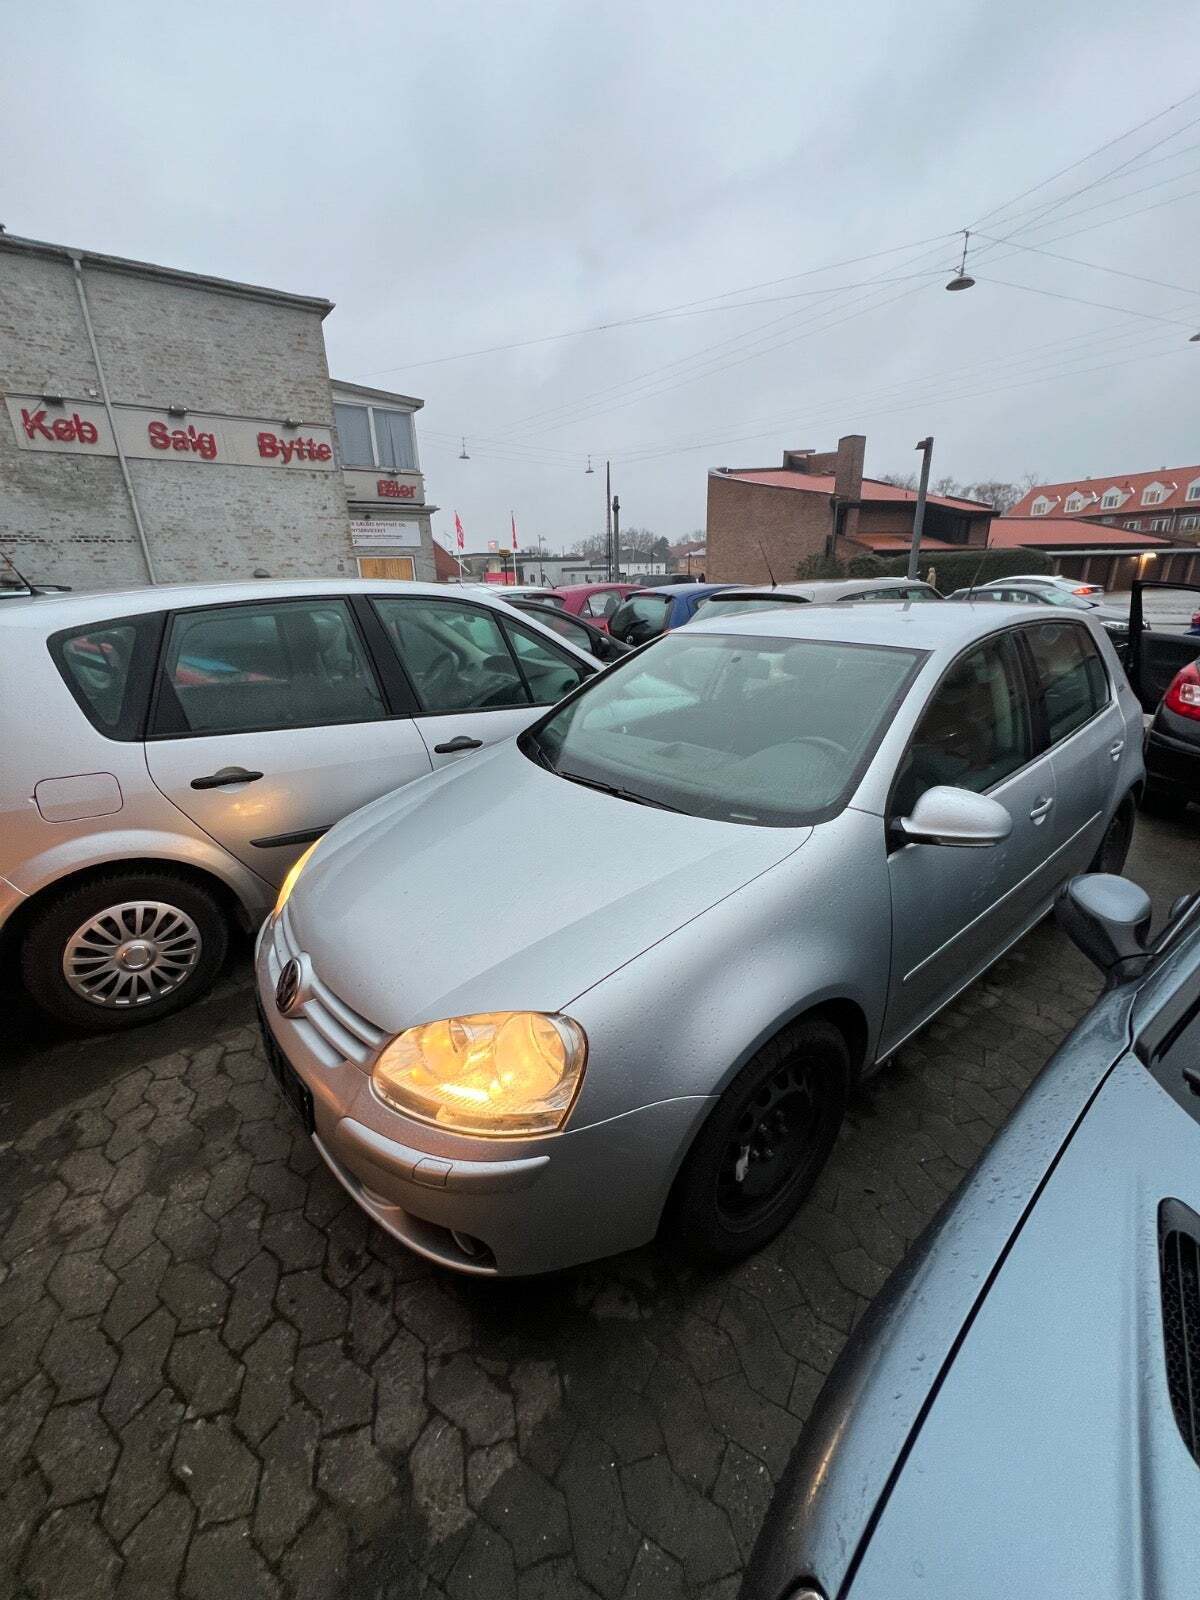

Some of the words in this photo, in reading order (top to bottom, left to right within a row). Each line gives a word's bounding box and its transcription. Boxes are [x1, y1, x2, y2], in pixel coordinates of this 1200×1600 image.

[21, 408, 98, 444] Køb
[148, 421, 218, 460] Salg
[257, 431, 332, 464] Bytte
